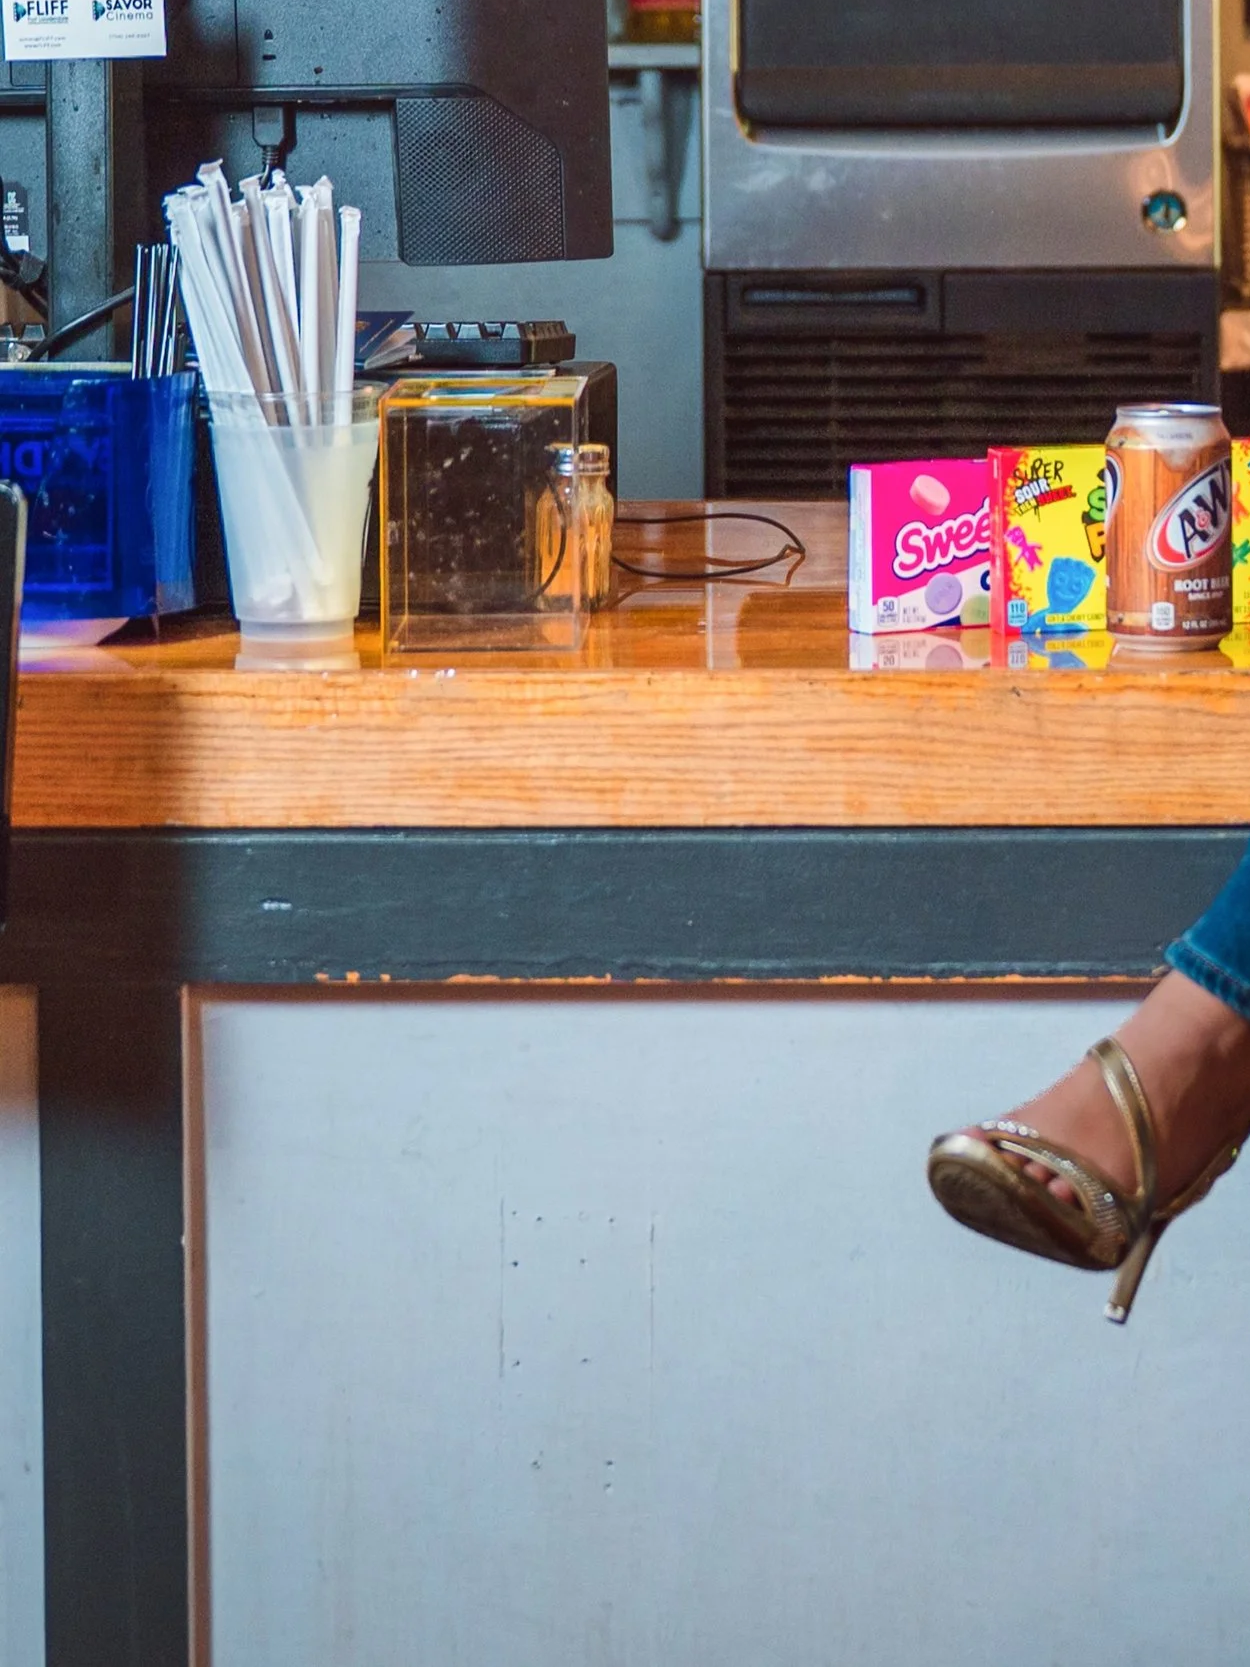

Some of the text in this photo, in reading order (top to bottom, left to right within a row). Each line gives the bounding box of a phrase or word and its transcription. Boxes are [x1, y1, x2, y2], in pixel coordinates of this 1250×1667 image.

[27, 0, 69, 16] FLIFF
[106, 11, 153, 21] Cinema
[1014, 477, 1051, 504] SOUR
[1176, 458, 1231, 560] A&W
[1173, 578, 1209, 592] ROOT
[882, 599, 895, 612] 50
[1010, 602, 1025, 613] 110
